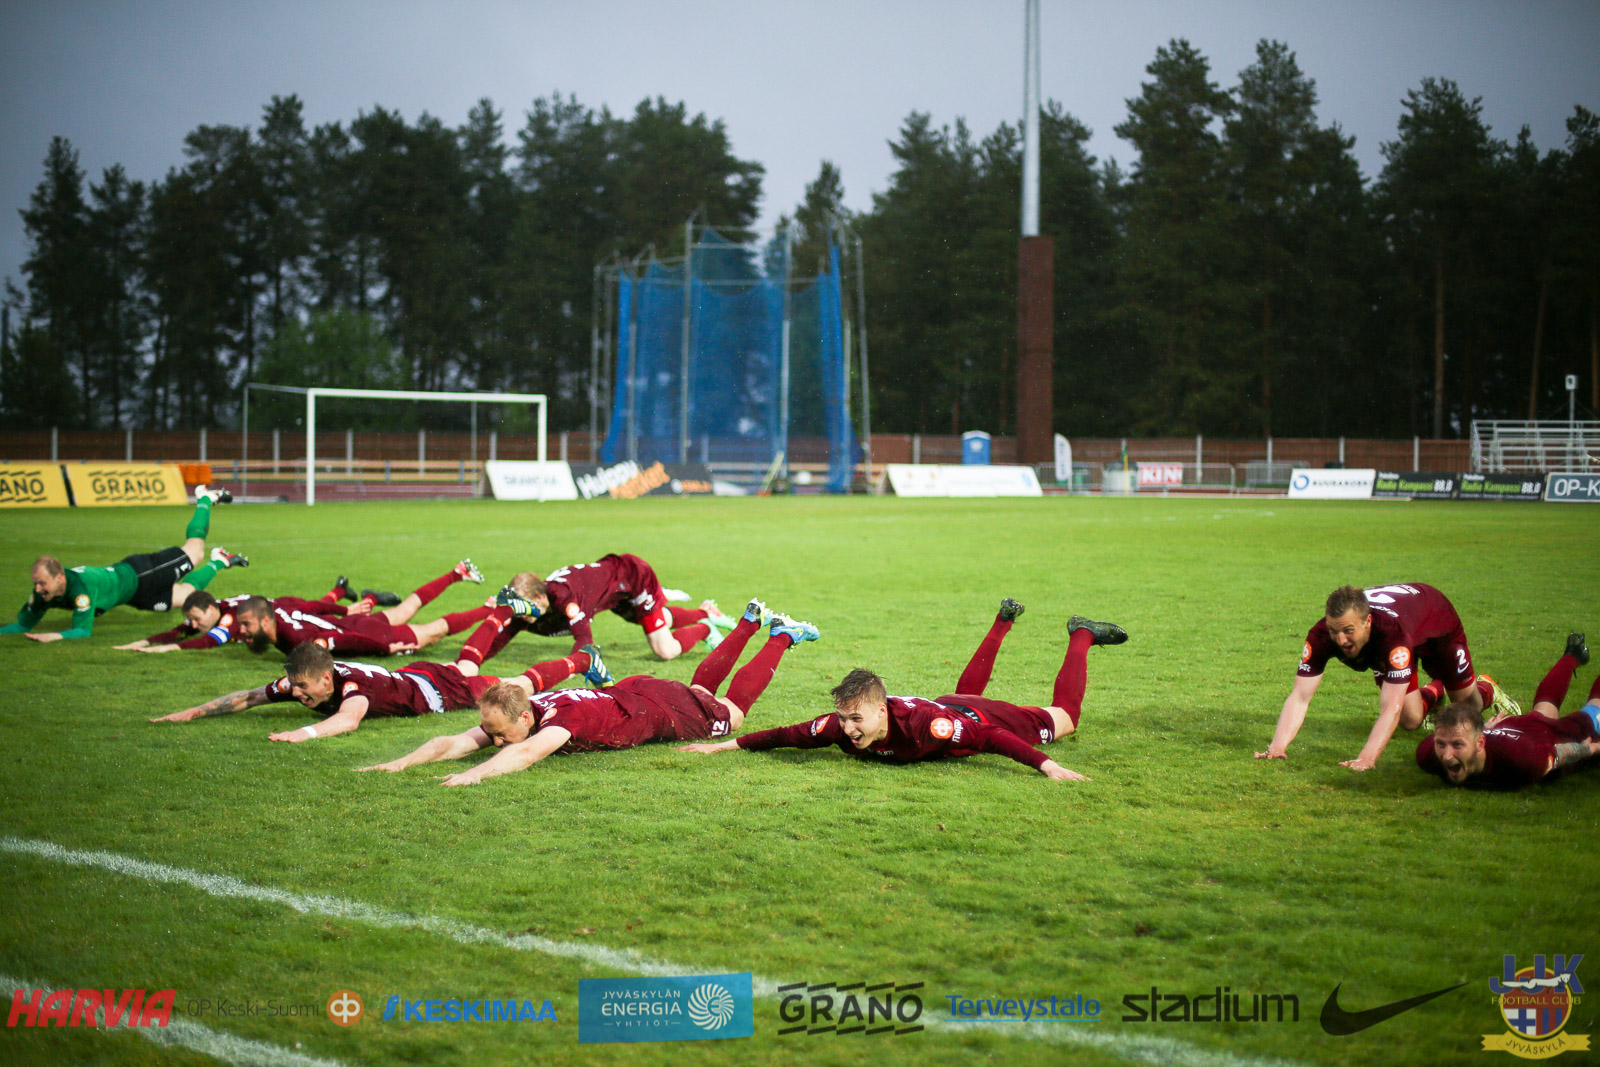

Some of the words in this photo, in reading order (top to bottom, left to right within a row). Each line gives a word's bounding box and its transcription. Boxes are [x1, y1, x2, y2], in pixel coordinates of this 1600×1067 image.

[92, 477, 165, 495] GRANO
[1554, 478, 1600, 497] OP-K
[1456, 649, 1467, 665] 2
